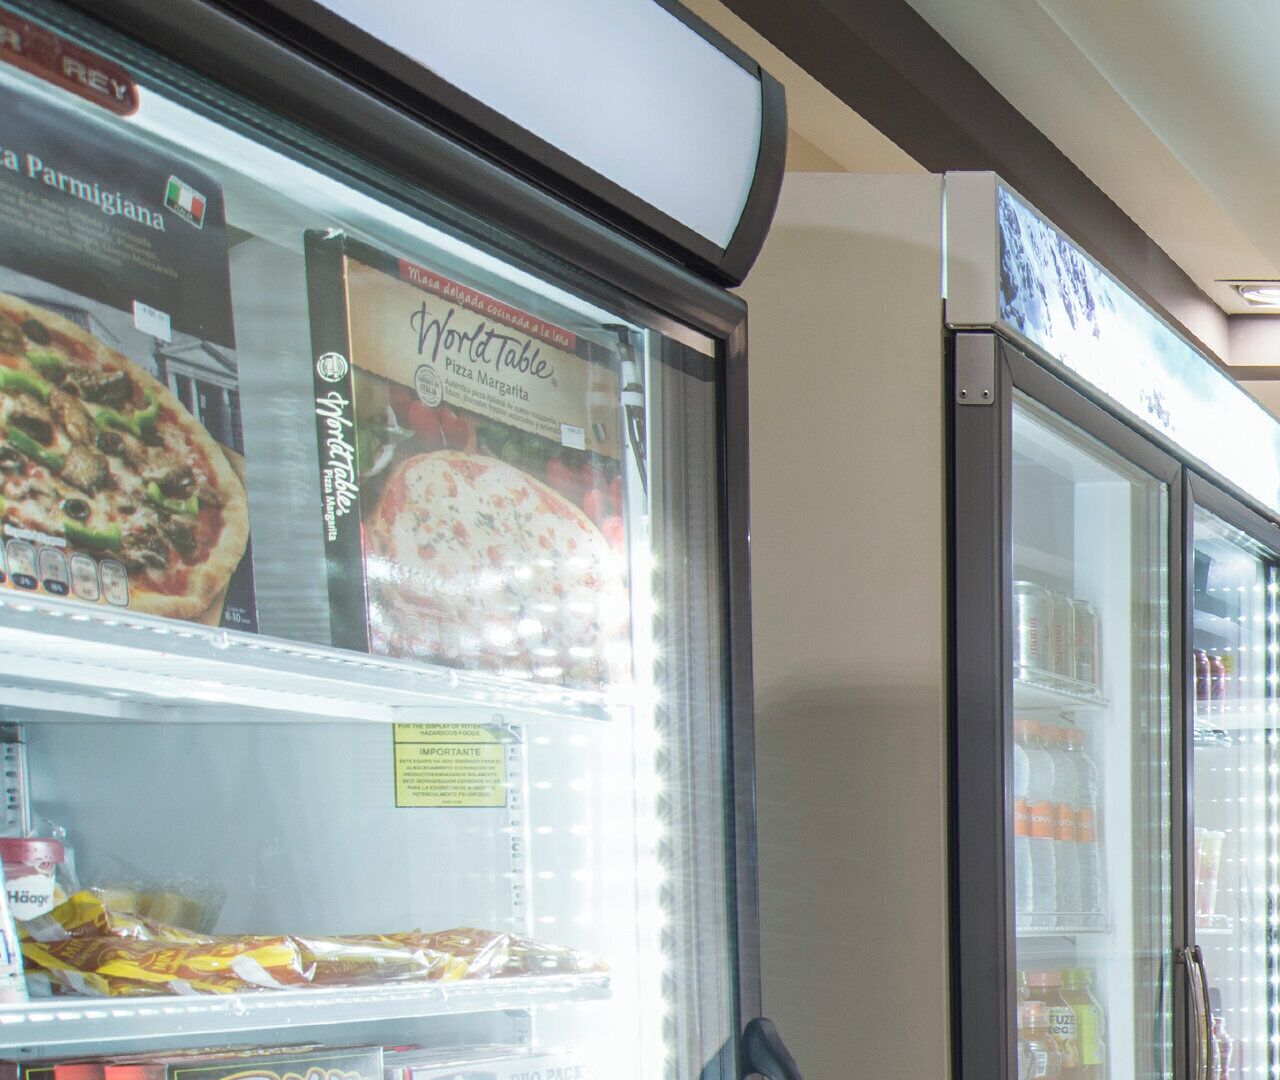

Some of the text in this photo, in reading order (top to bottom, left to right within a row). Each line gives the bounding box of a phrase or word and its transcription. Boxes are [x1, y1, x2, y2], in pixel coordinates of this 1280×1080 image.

[63, 56, 128, 100] REY
[27, 153, 166, 232] Parmigiana
[408, 266, 440, 290] Masa
[443, 282, 484, 310] delgada
[486, 303, 530, 330] cocinada
[445, 357, 474, 381] Pizza
[477, 370, 529, 402] Margarita
[324, 469, 337, 541] Pizza Margarita
[420, 748, 481, 756] IMPORTANTE
